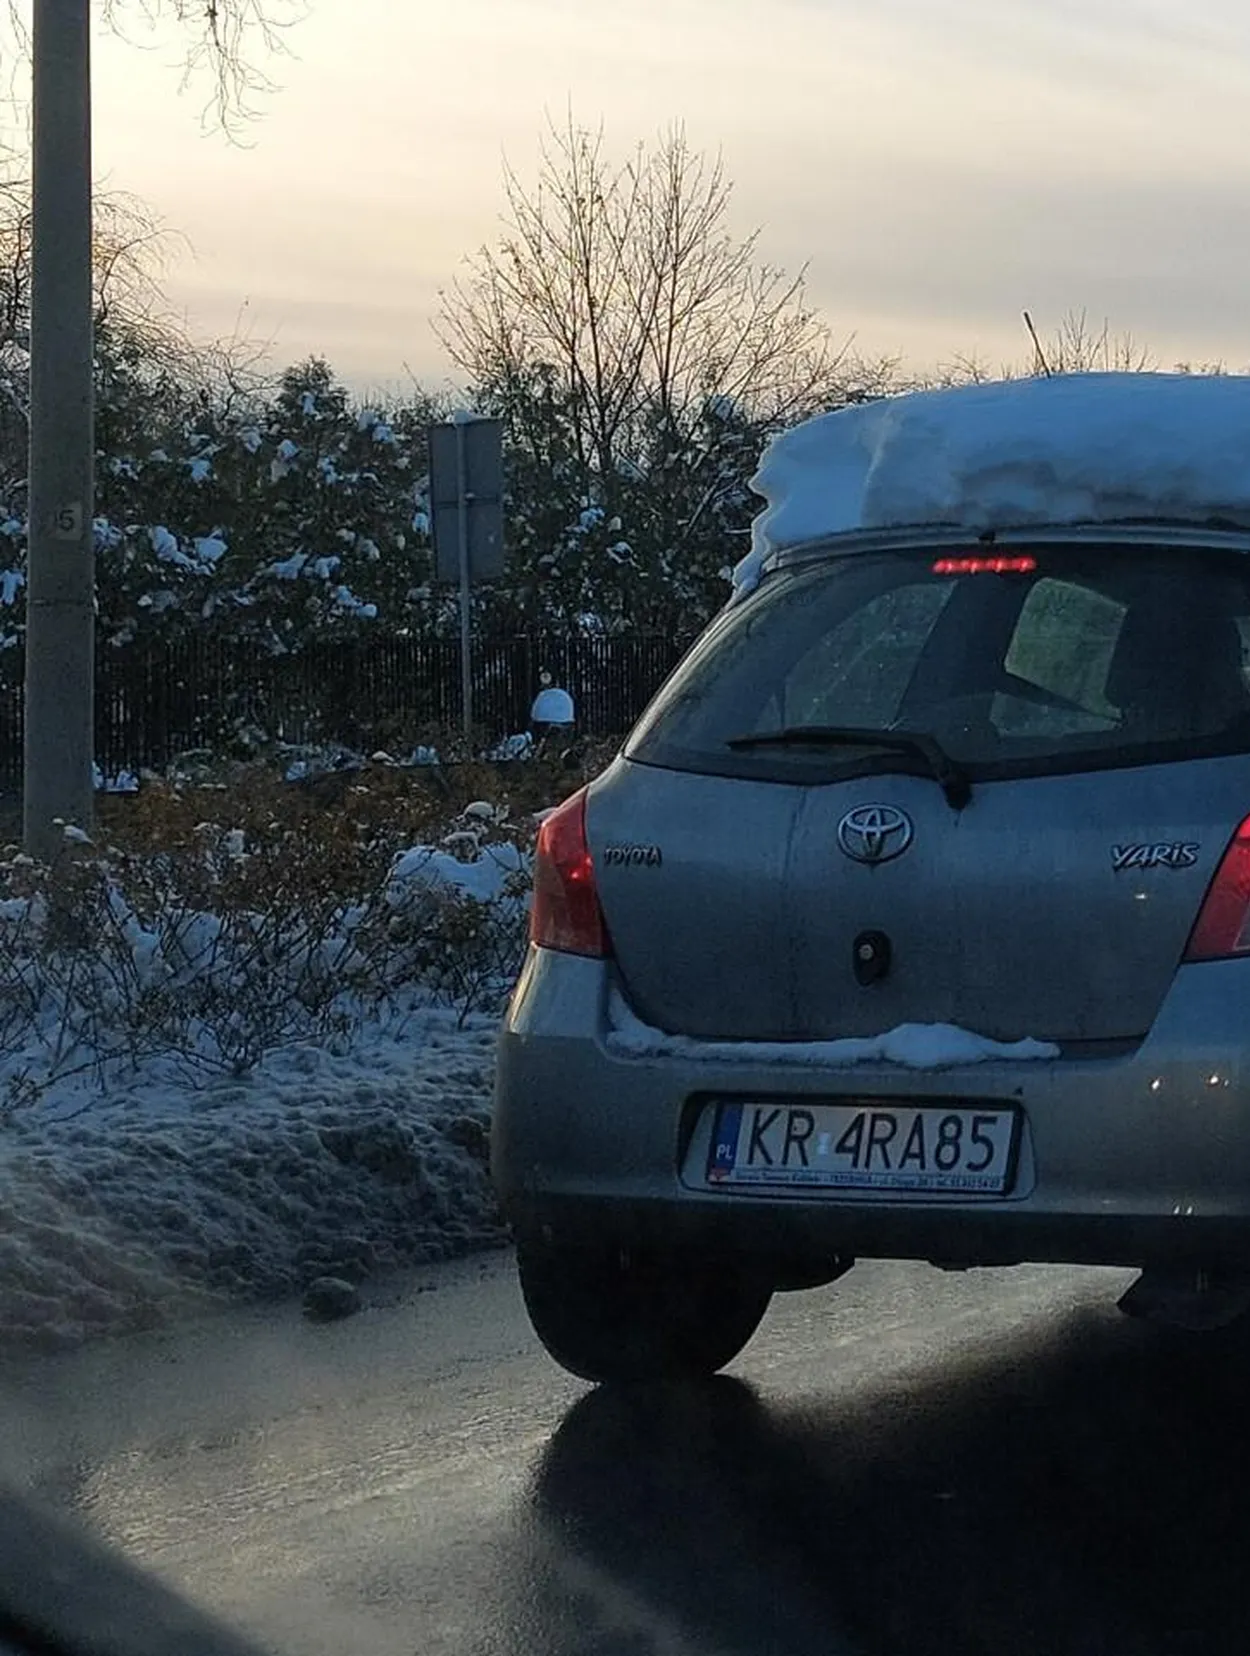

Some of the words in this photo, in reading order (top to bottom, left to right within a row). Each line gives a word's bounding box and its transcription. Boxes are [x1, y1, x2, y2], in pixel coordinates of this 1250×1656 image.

[603, 845, 662, 867] TOYOTA
[716, 1143, 734, 1160] PL
[746, 1108, 815, 1167] KR
[835, 1111, 998, 1173] 4RA85
